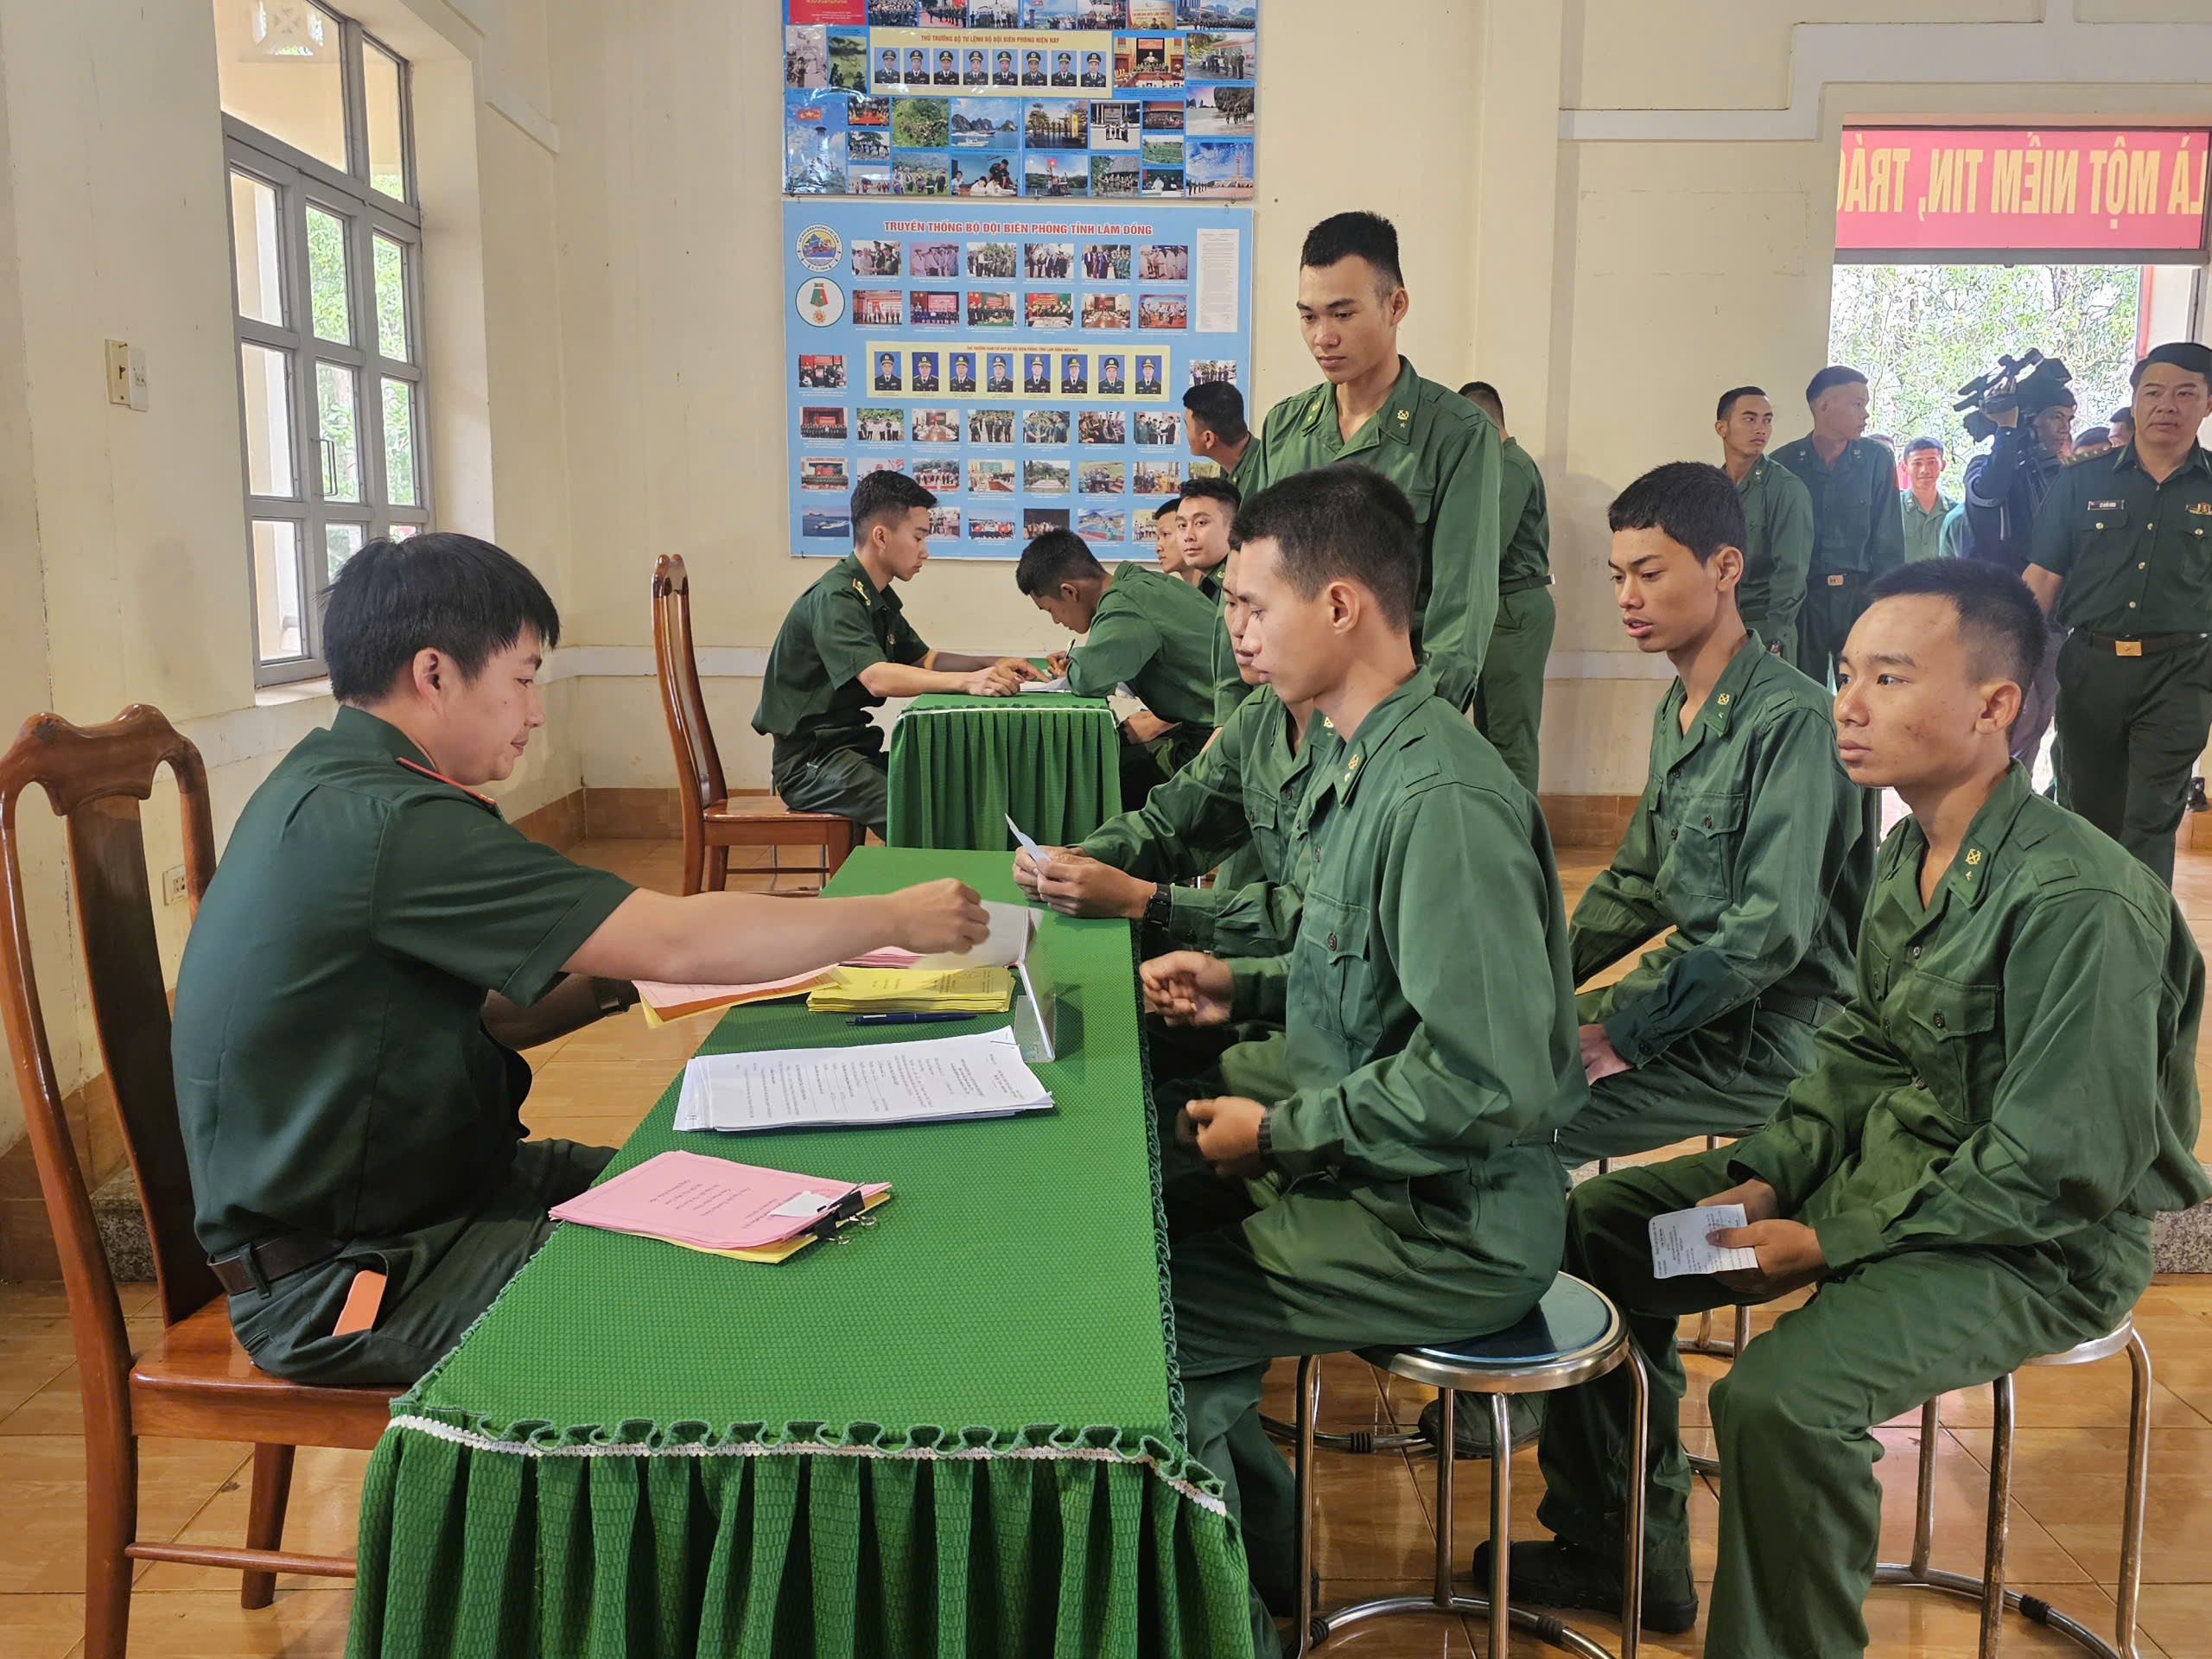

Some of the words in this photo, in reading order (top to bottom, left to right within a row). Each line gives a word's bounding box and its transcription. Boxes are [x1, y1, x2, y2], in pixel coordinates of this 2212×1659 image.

[884, 219, 925, 232] TRUYỀN
[927, 219, 963, 232] THỐNG
[965, 222, 980, 234] BỘ
[982, 222, 1001, 234] ĐỘI
[1003, 222, 1028, 233] BIÊN
[1032, 222, 1067, 234] PHÒNG
[1071, 222, 1094, 234] TỈNH
[1097, 223, 1120, 235] LÂM
[1123, 221, 1152, 235] ĐỒNG
